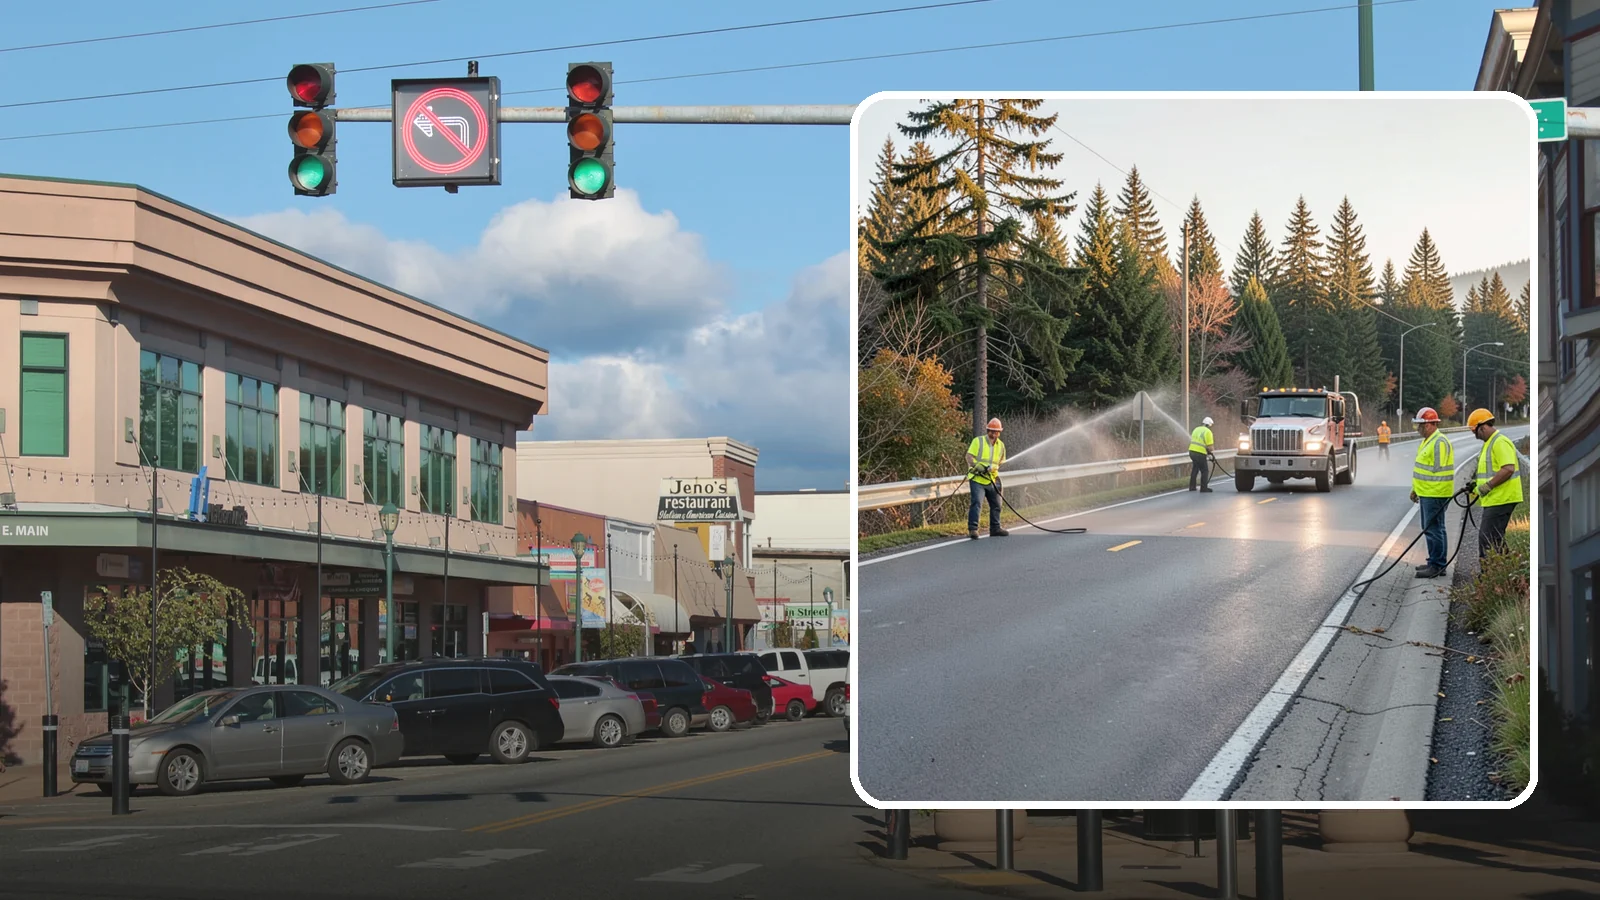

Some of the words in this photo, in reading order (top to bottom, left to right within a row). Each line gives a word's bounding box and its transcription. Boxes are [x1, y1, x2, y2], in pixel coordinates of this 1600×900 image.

[669, 480, 727, 495] Jeno's
[665, 496, 731, 509] restaurant
[658, 510, 681, 520] Italian
[686, 509, 715, 520] American
[715, 509, 738, 520] Cuisine
[2, 525, 13, 536] E.
[15, 525, 49, 536] MAIN
[797, 607, 829, 617] Street
[791, 619, 824, 627] lass
